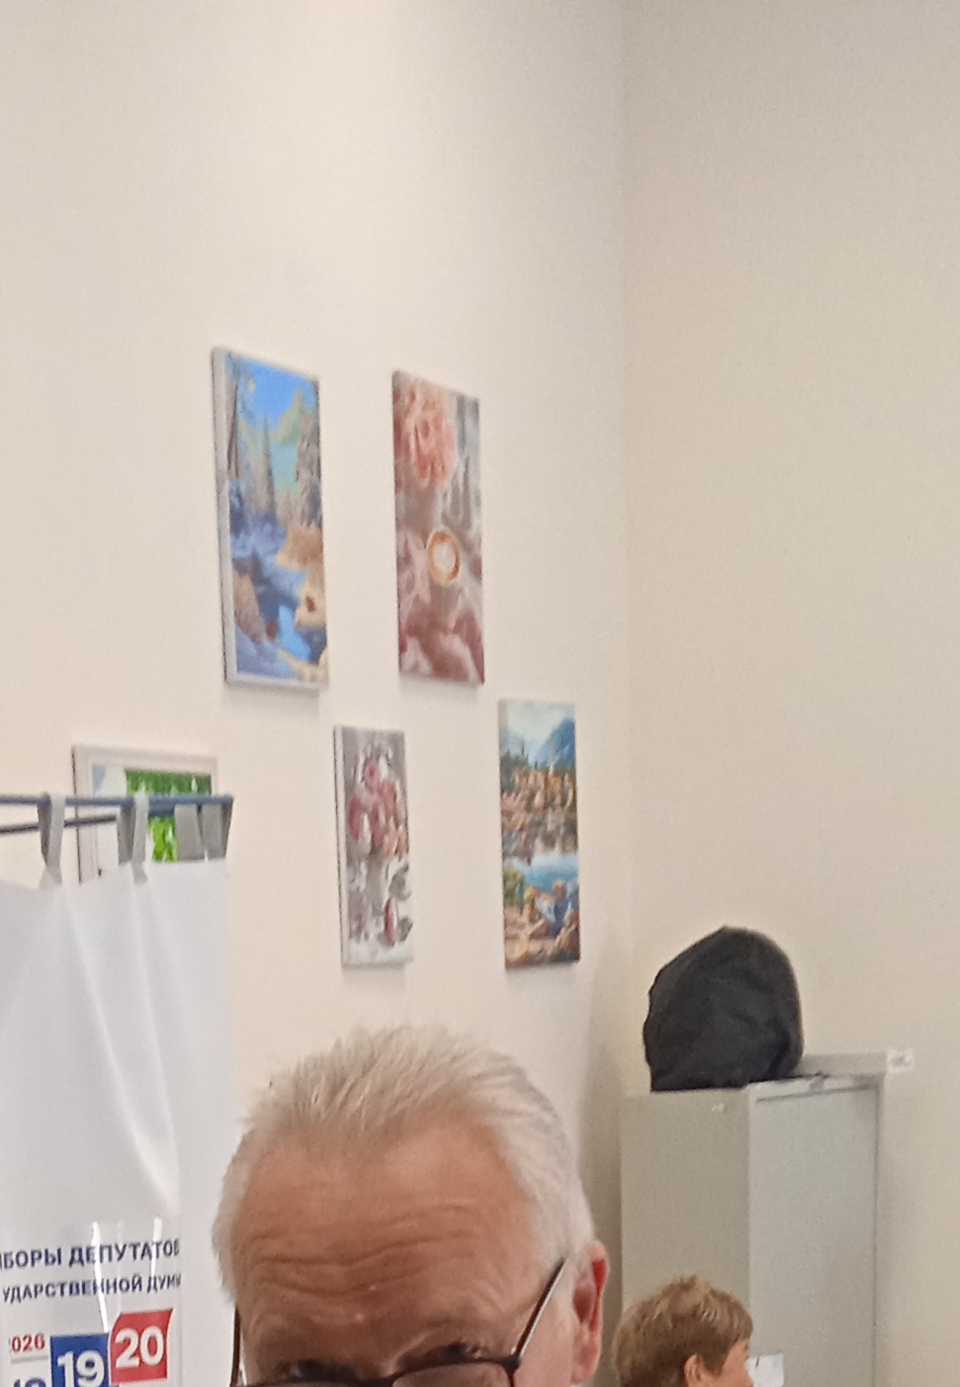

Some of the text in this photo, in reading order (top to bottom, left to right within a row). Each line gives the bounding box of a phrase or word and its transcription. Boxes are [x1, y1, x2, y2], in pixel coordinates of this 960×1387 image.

[68, 1238, 180, 1268] ДЕПУТАТОВ
[8, 1333, 46, 1353] 026
[114, 1324, 165, 1369] 20
